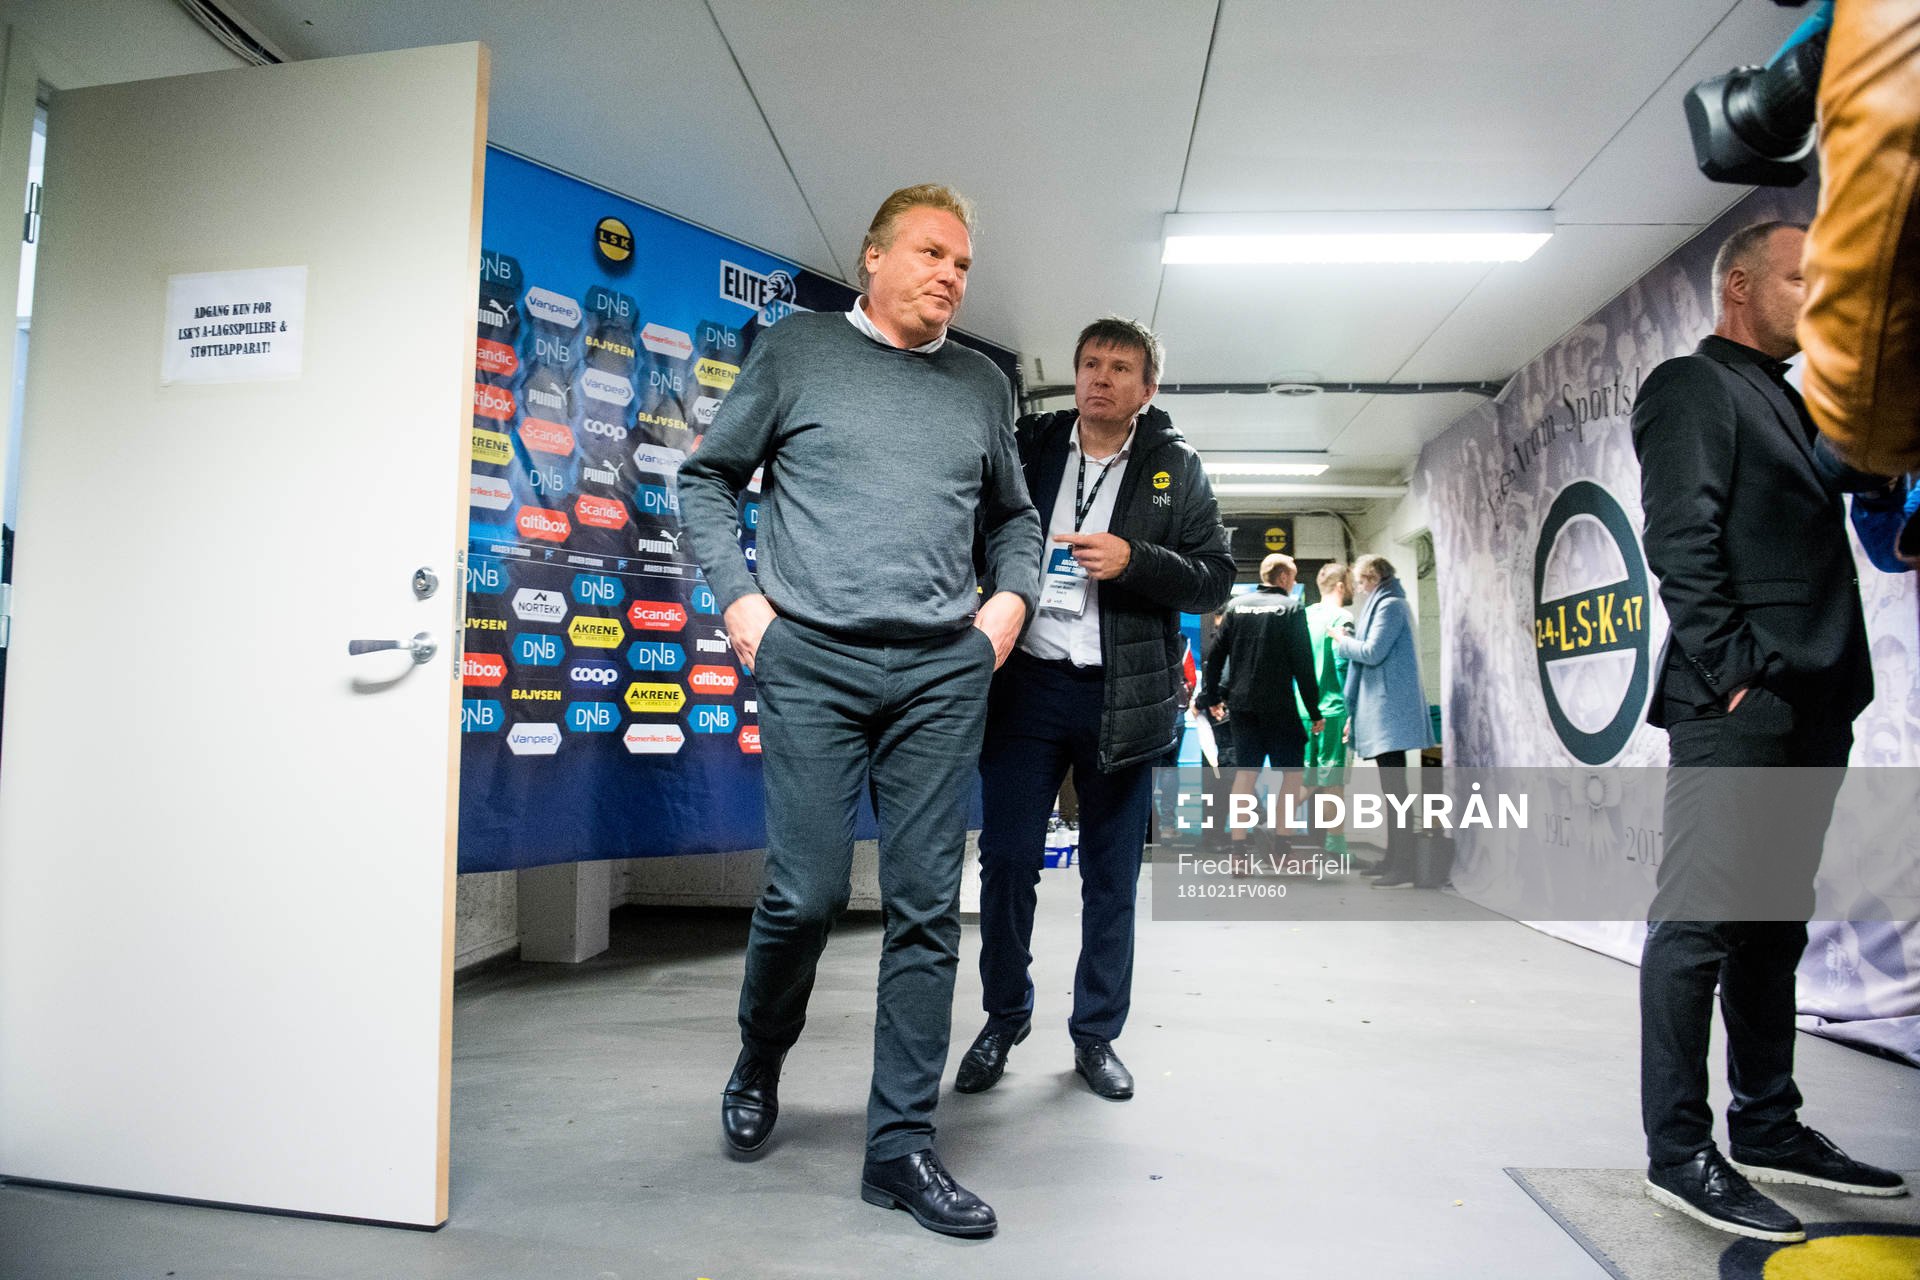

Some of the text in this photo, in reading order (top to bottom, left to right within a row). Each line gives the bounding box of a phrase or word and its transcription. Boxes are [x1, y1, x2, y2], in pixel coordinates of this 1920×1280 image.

[724, 265, 767, 307] ELITE
[194, 301, 272, 319] ADGANG KUN FOR
[597, 292, 630, 319] DNB
[178, 320, 288, 340] LSK'S A-LAGSSPILLERE &
[706, 325, 737, 350] DNB
[190, 341, 271, 359] STØTTEAPPARAT!
[477, 348, 513, 366] andic
[536, 337, 570, 365] DNB
[650, 368, 682, 395] DNB
[474, 390, 511, 412] tibox
[584, 418, 628, 442] coop
[529, 466, 563, 496] DNB
[580, 501, 622, 520] Scandic
[645, 486, 680, 515] DNB
[521, 514, 567, 534] altibox
[638, 539, 673, 554] PUMA
[581, 575, 615, 605] DNB
[518, 601, 561, 614] NORTEKK
[634, 607, 682, 621] Scandic
[523, 635, 556, 666] DNB
[640, 642, 676, 671] DNB
[696, 639, 727, 653] PUMA
[463, 660, 502, 677] tibox
[570, 667, 618, 686] coop
[693, 671, 735, 687] altibox
[576, 702, 610, 733] DNB
[699, 705, 730, 734] DNB
